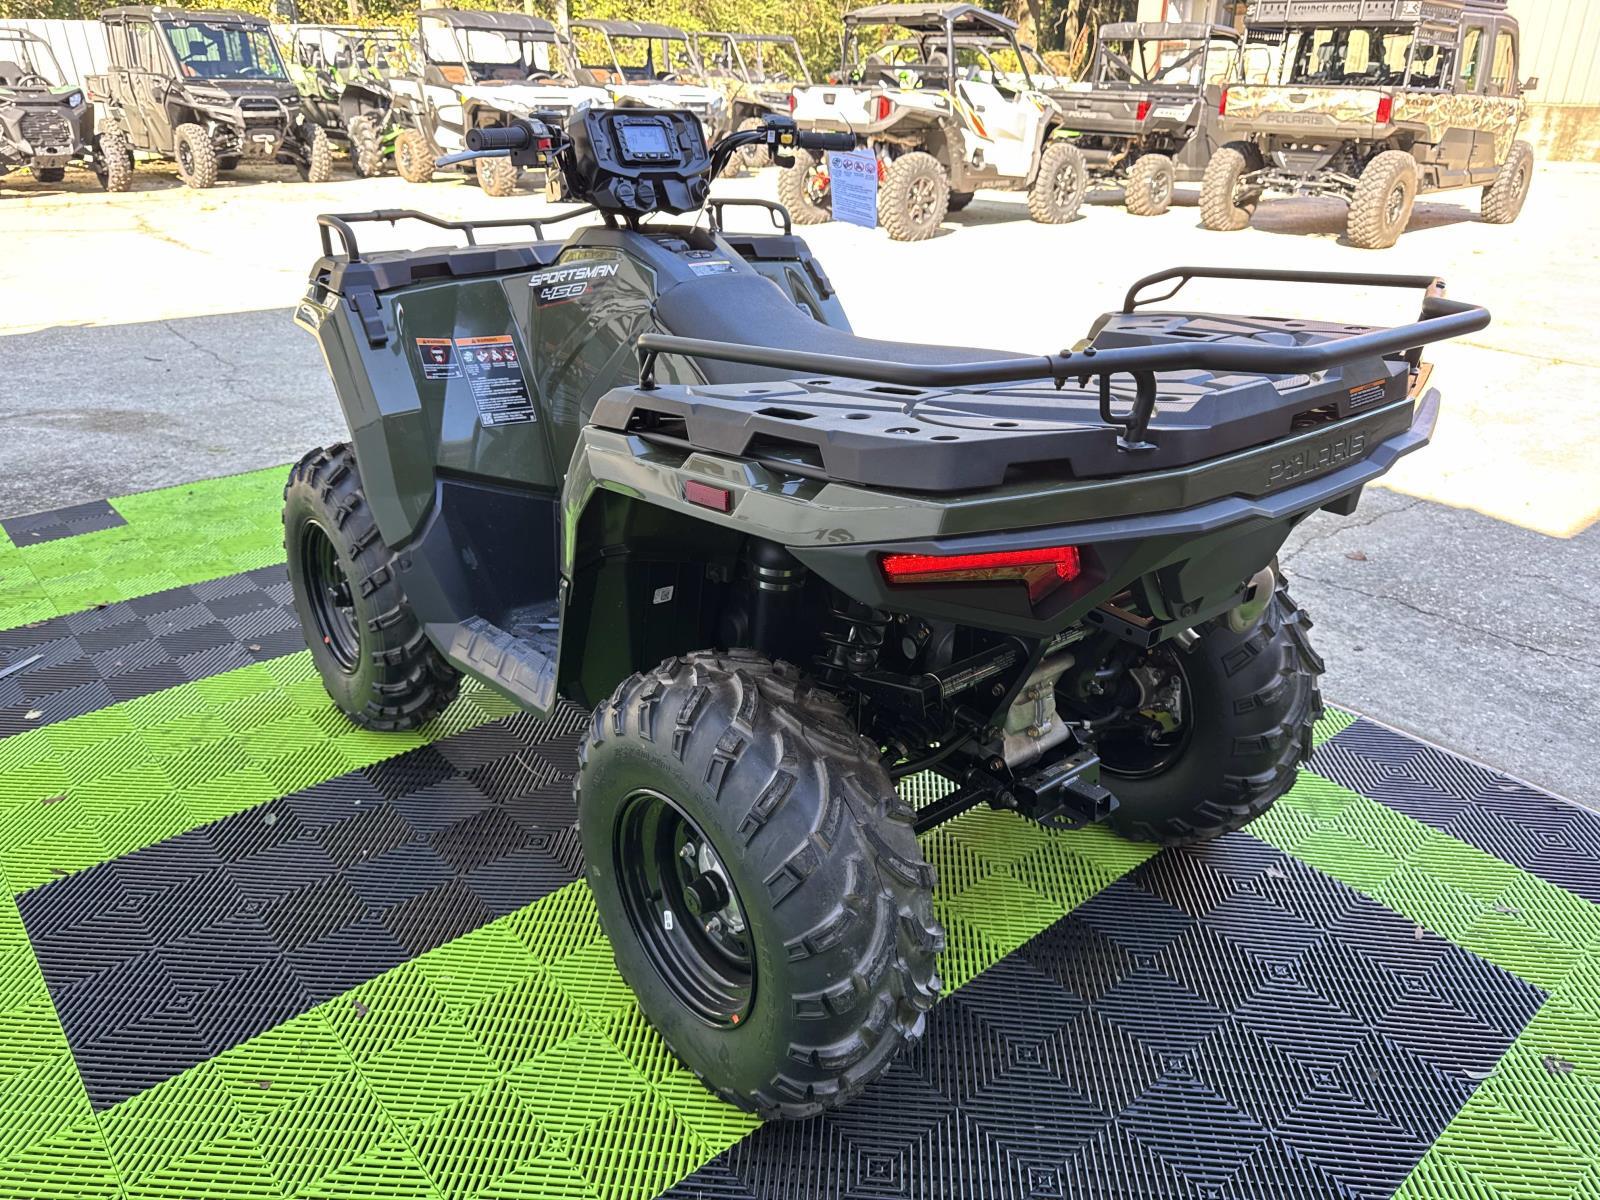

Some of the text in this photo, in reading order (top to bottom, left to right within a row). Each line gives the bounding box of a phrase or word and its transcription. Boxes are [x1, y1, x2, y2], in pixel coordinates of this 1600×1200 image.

[1265, 114, 1324, 125] POLARIS
[528, 263, 620, 287] SPORTSMAN
[540, 281, 588, 301] 450
